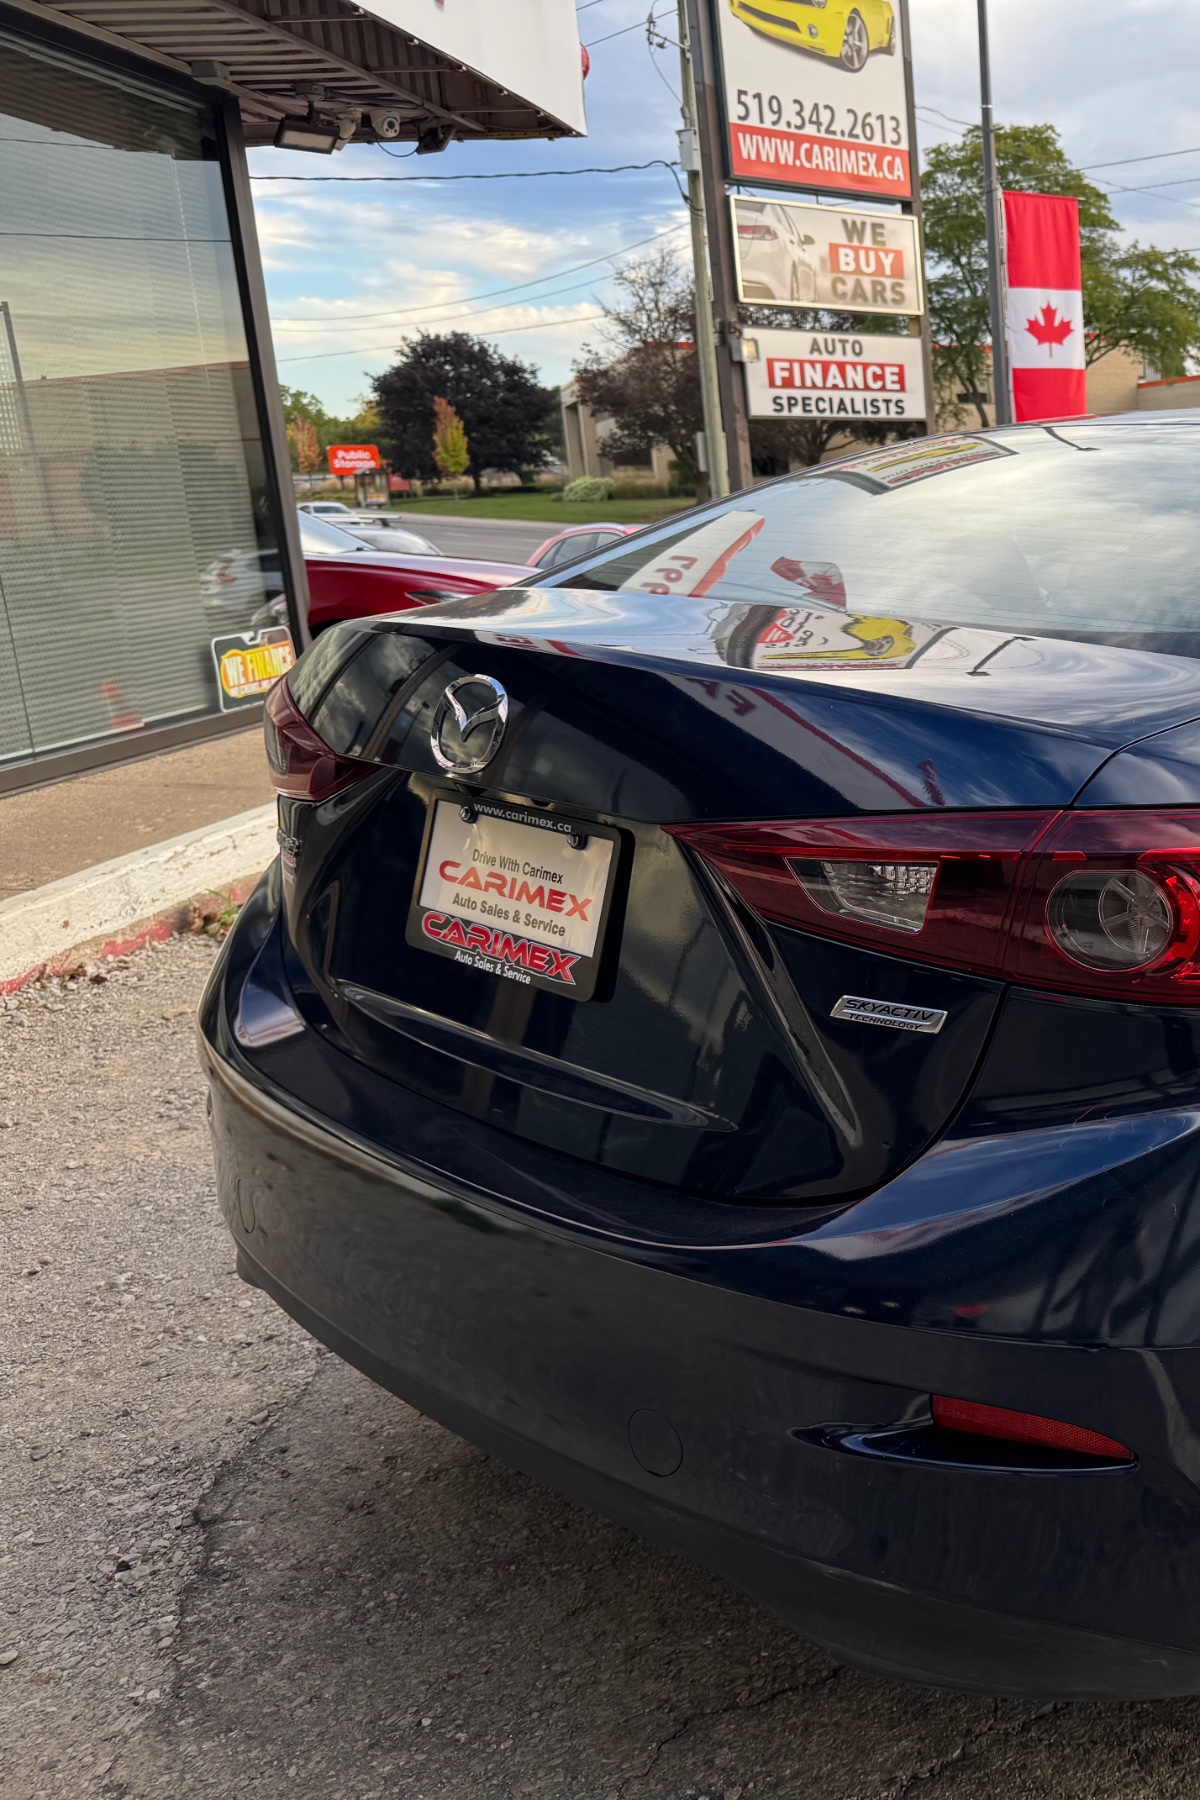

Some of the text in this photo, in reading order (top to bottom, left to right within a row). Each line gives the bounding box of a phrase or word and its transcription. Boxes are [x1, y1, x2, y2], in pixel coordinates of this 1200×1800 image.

[737, 89, 902, 145] 519.342.2613
[737, 132, 905, 182] WWW.CARIMEX.CA
[841, 218, 887, 247] WE
[837, 247, 895, 276] BUY
[831, 276, 906, 305] CARS
[809, 337, 863, 357] AUTO
[772, 361, 901, 391] FINANCE
[772, 395, 906, 416] SPECIALISTS
[336, 450, 371, 460] Public
[473, 803, 572, 833] www.carimex.ca
[472, 848, 564, 884] Drive With Carimex
[438, 860, 593, 922] CARIMEX
[452, 892, 566, 937] Auto Sales & Service
[422, 911, 579, 984] CARIMEX
[454, 950, 531, 985] Auto Sales & Service
[844, 999, 936, 1020] SKYACTIV
[849, 1012, 923, 1030] TECHNOLOGY
